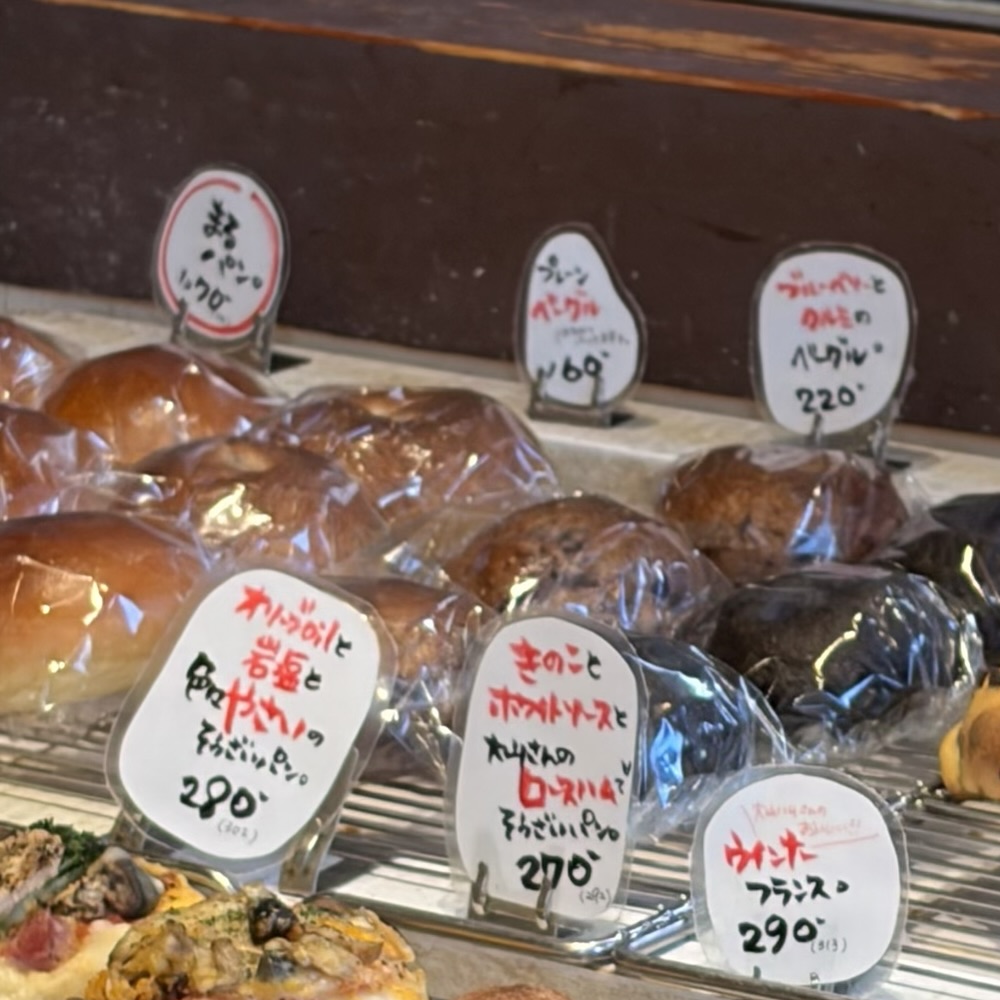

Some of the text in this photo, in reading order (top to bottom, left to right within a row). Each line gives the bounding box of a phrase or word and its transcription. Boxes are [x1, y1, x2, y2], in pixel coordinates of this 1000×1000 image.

[243, 636, 322, 693] 岩塩と
[508, 635, 603, 685] きのこと
